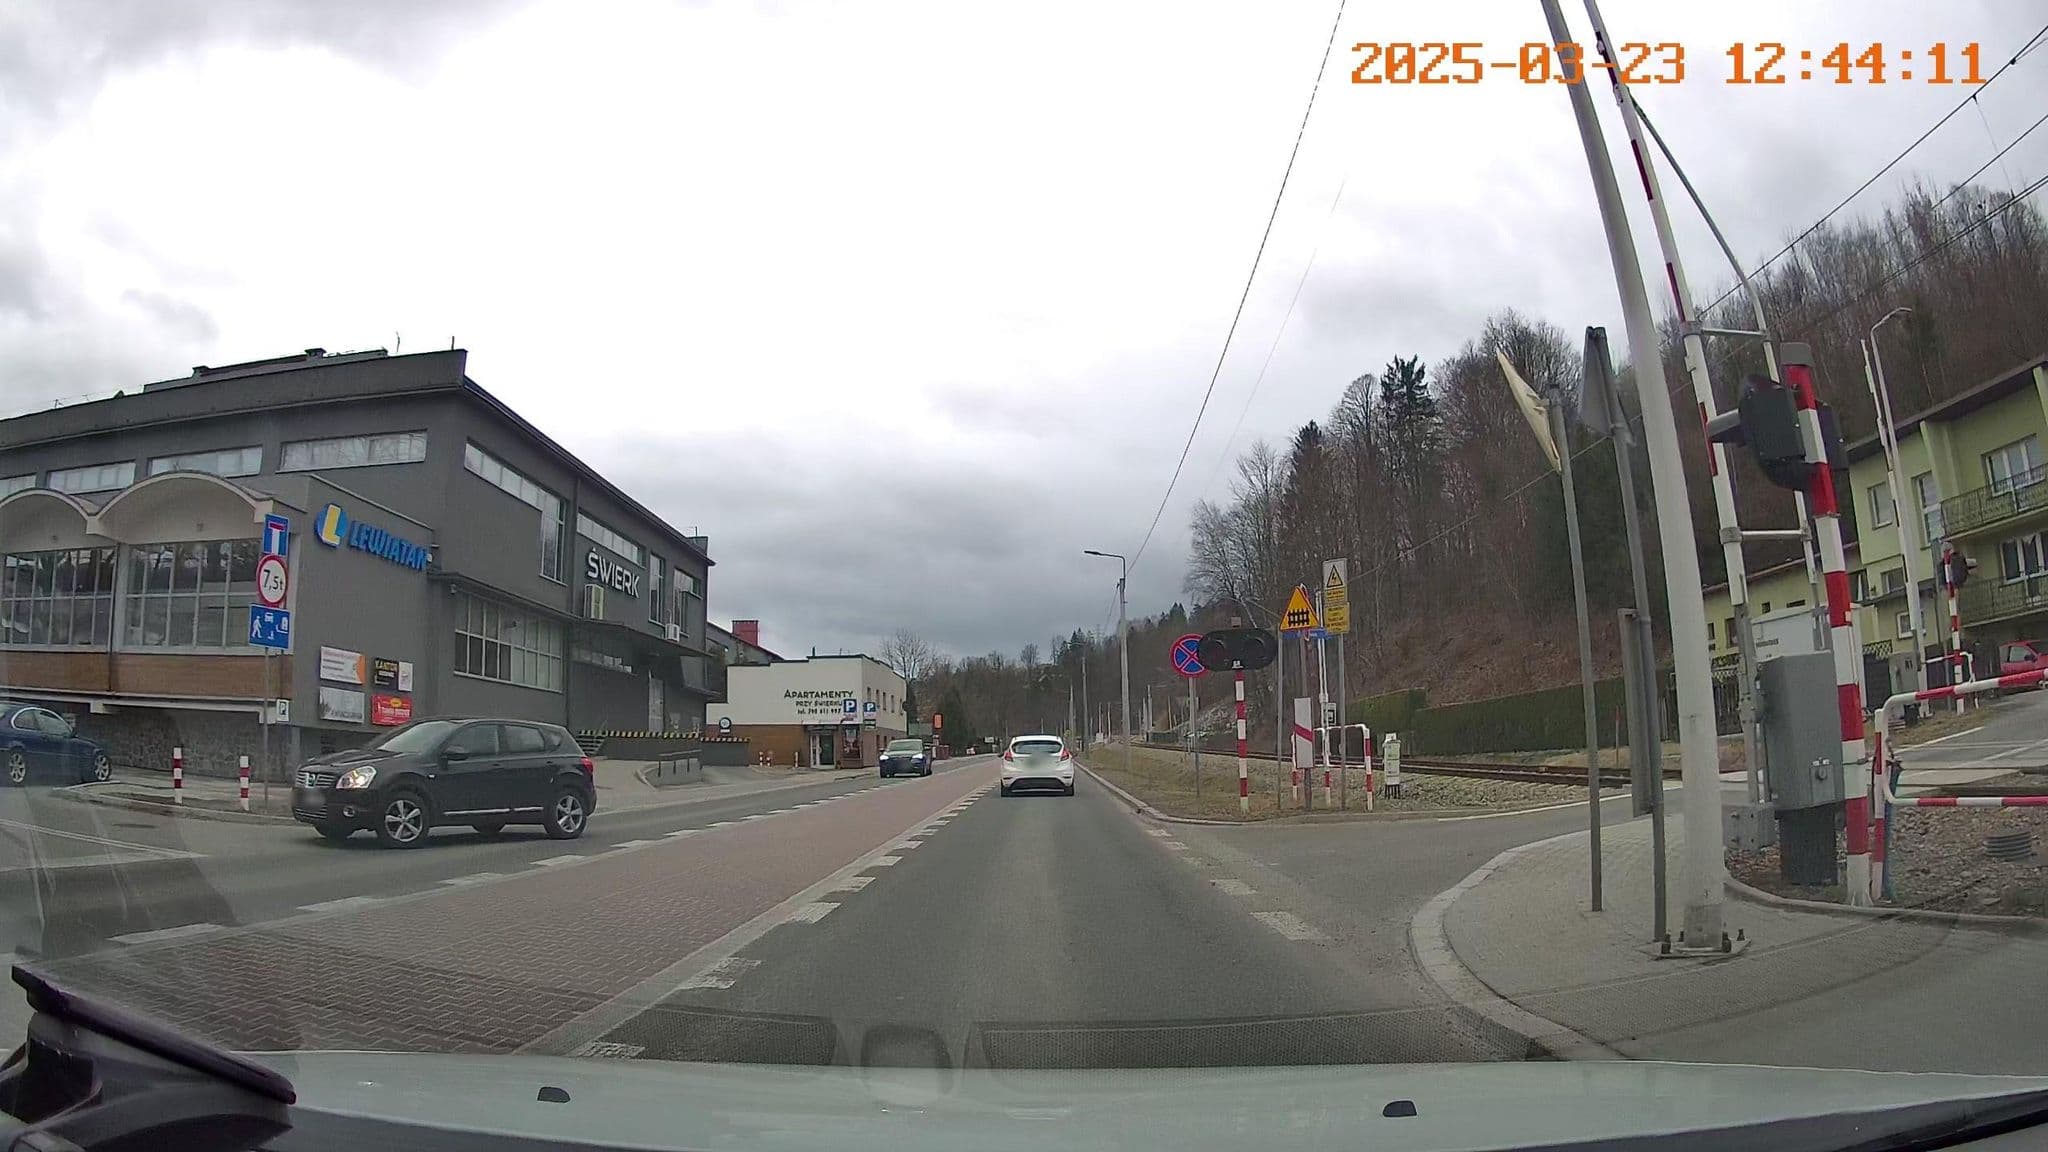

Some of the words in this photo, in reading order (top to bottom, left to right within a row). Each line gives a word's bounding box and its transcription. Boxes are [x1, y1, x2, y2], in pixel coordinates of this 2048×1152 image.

[348, 520, 428, 571] LEWIATAN
[263, 569, 283, 591] 7,5t
[587, 547, 640, 599] ŚWIERK
